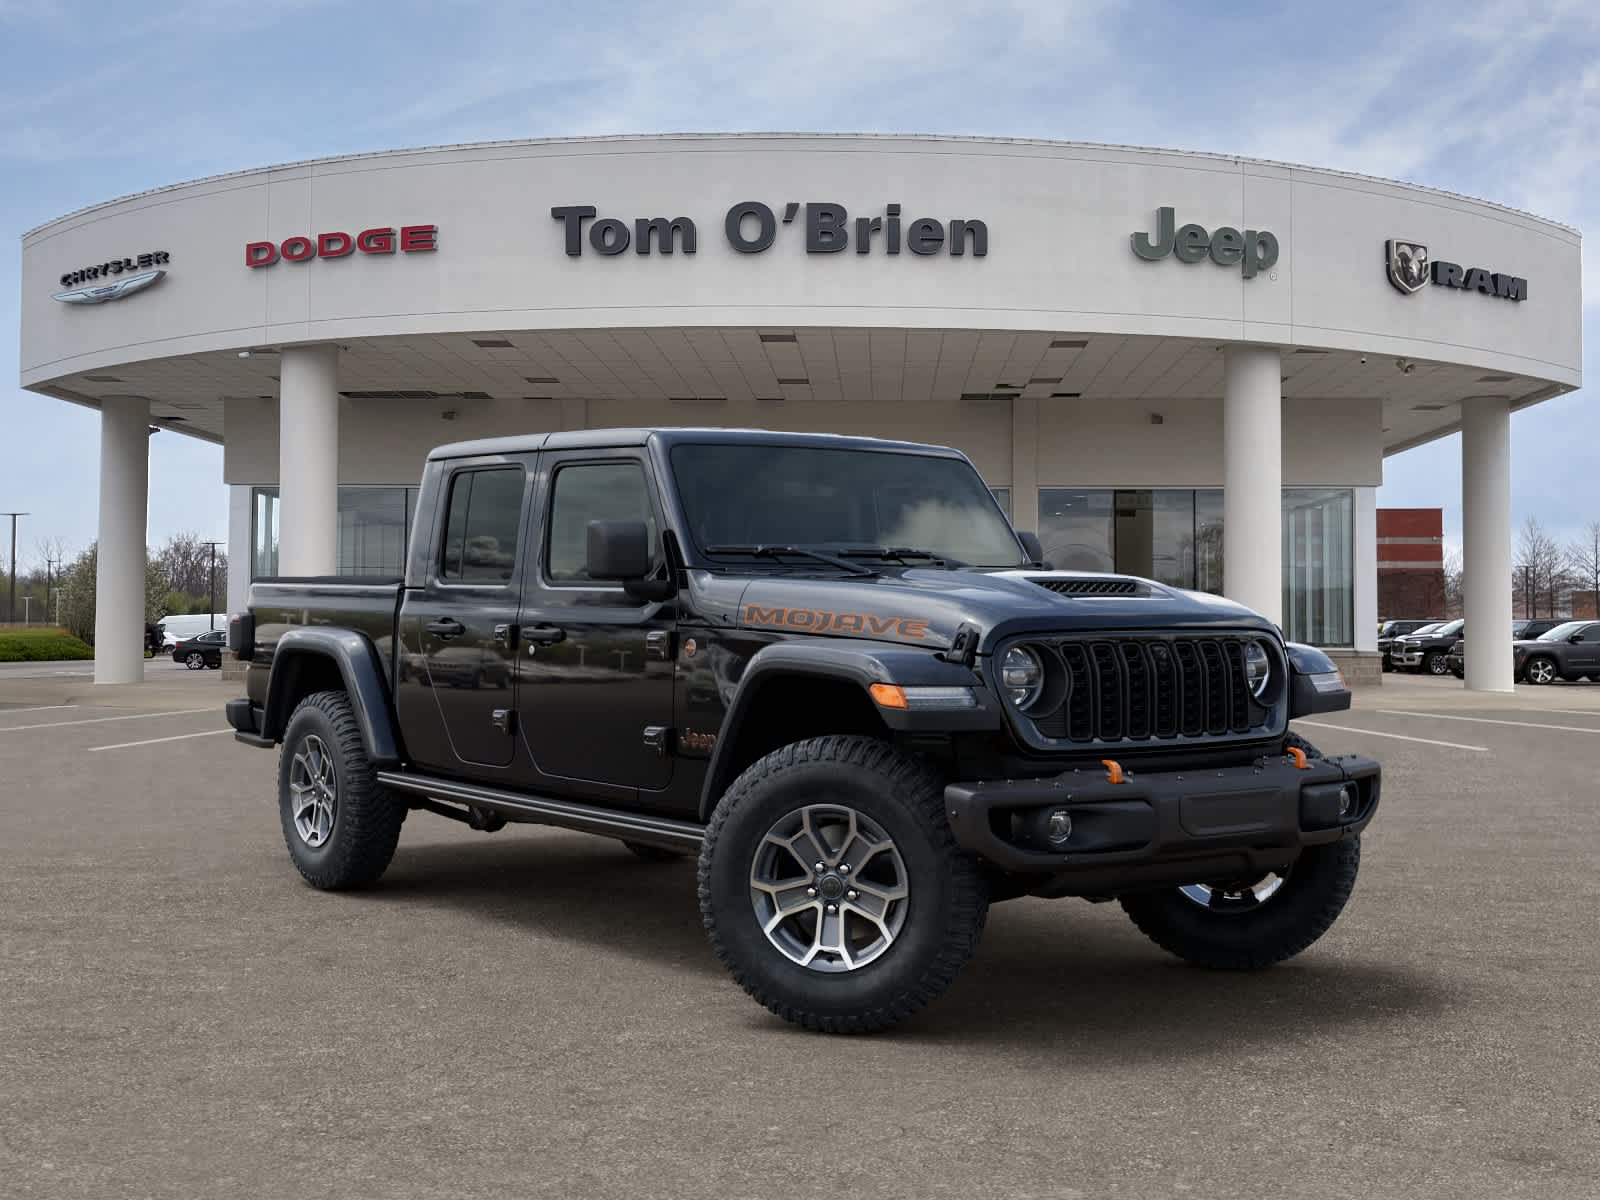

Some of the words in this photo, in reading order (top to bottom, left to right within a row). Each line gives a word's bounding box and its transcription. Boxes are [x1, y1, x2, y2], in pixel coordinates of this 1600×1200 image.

[245, 224, 438, 269] DODGE
[551, 205, 697, 257] Tom
[725, 201, 989, 257] O'Brien
[1130, 206, 1279, 279] Jeep
[60, 250, 170, 287] CHRYSLER
[1430, 260, 1528, 302] RAM
[743, 604, 929, 640] MOJAVE
